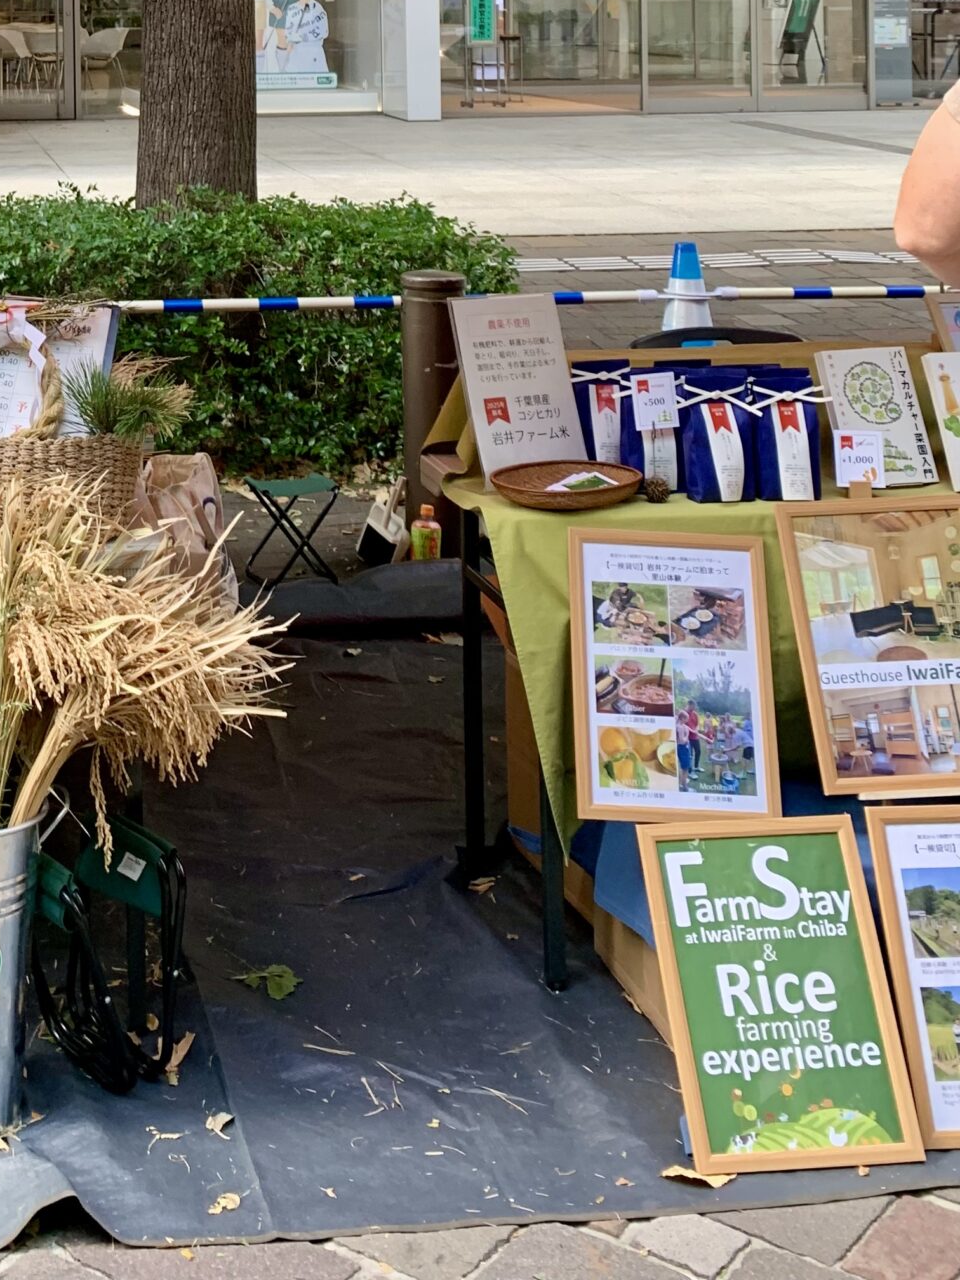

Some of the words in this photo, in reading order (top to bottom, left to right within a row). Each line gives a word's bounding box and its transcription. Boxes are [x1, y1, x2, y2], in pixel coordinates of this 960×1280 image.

[514, 394, 551, 408] 千葉県産
[518, 407, 561, 421] コシヒカリ
[893, 350, 935, 479] パーマカルチャー菜園入門
[492, 426, 571, 446] 岩井ファーム米
[820, 669, 903, 685] Guesthouse
[685, 931, 699, 945] at
[700, 925, 781, 944] IwaiFarm
[783, 926, 796, 939] in
[797, 919, 848, 938] Chiba
[762, 944, 778, 962] &
[715, 959, 838, 1018] Rice
[736, 1015, 834, 1043] farming
[702, 1038, 882, 1081] experience
